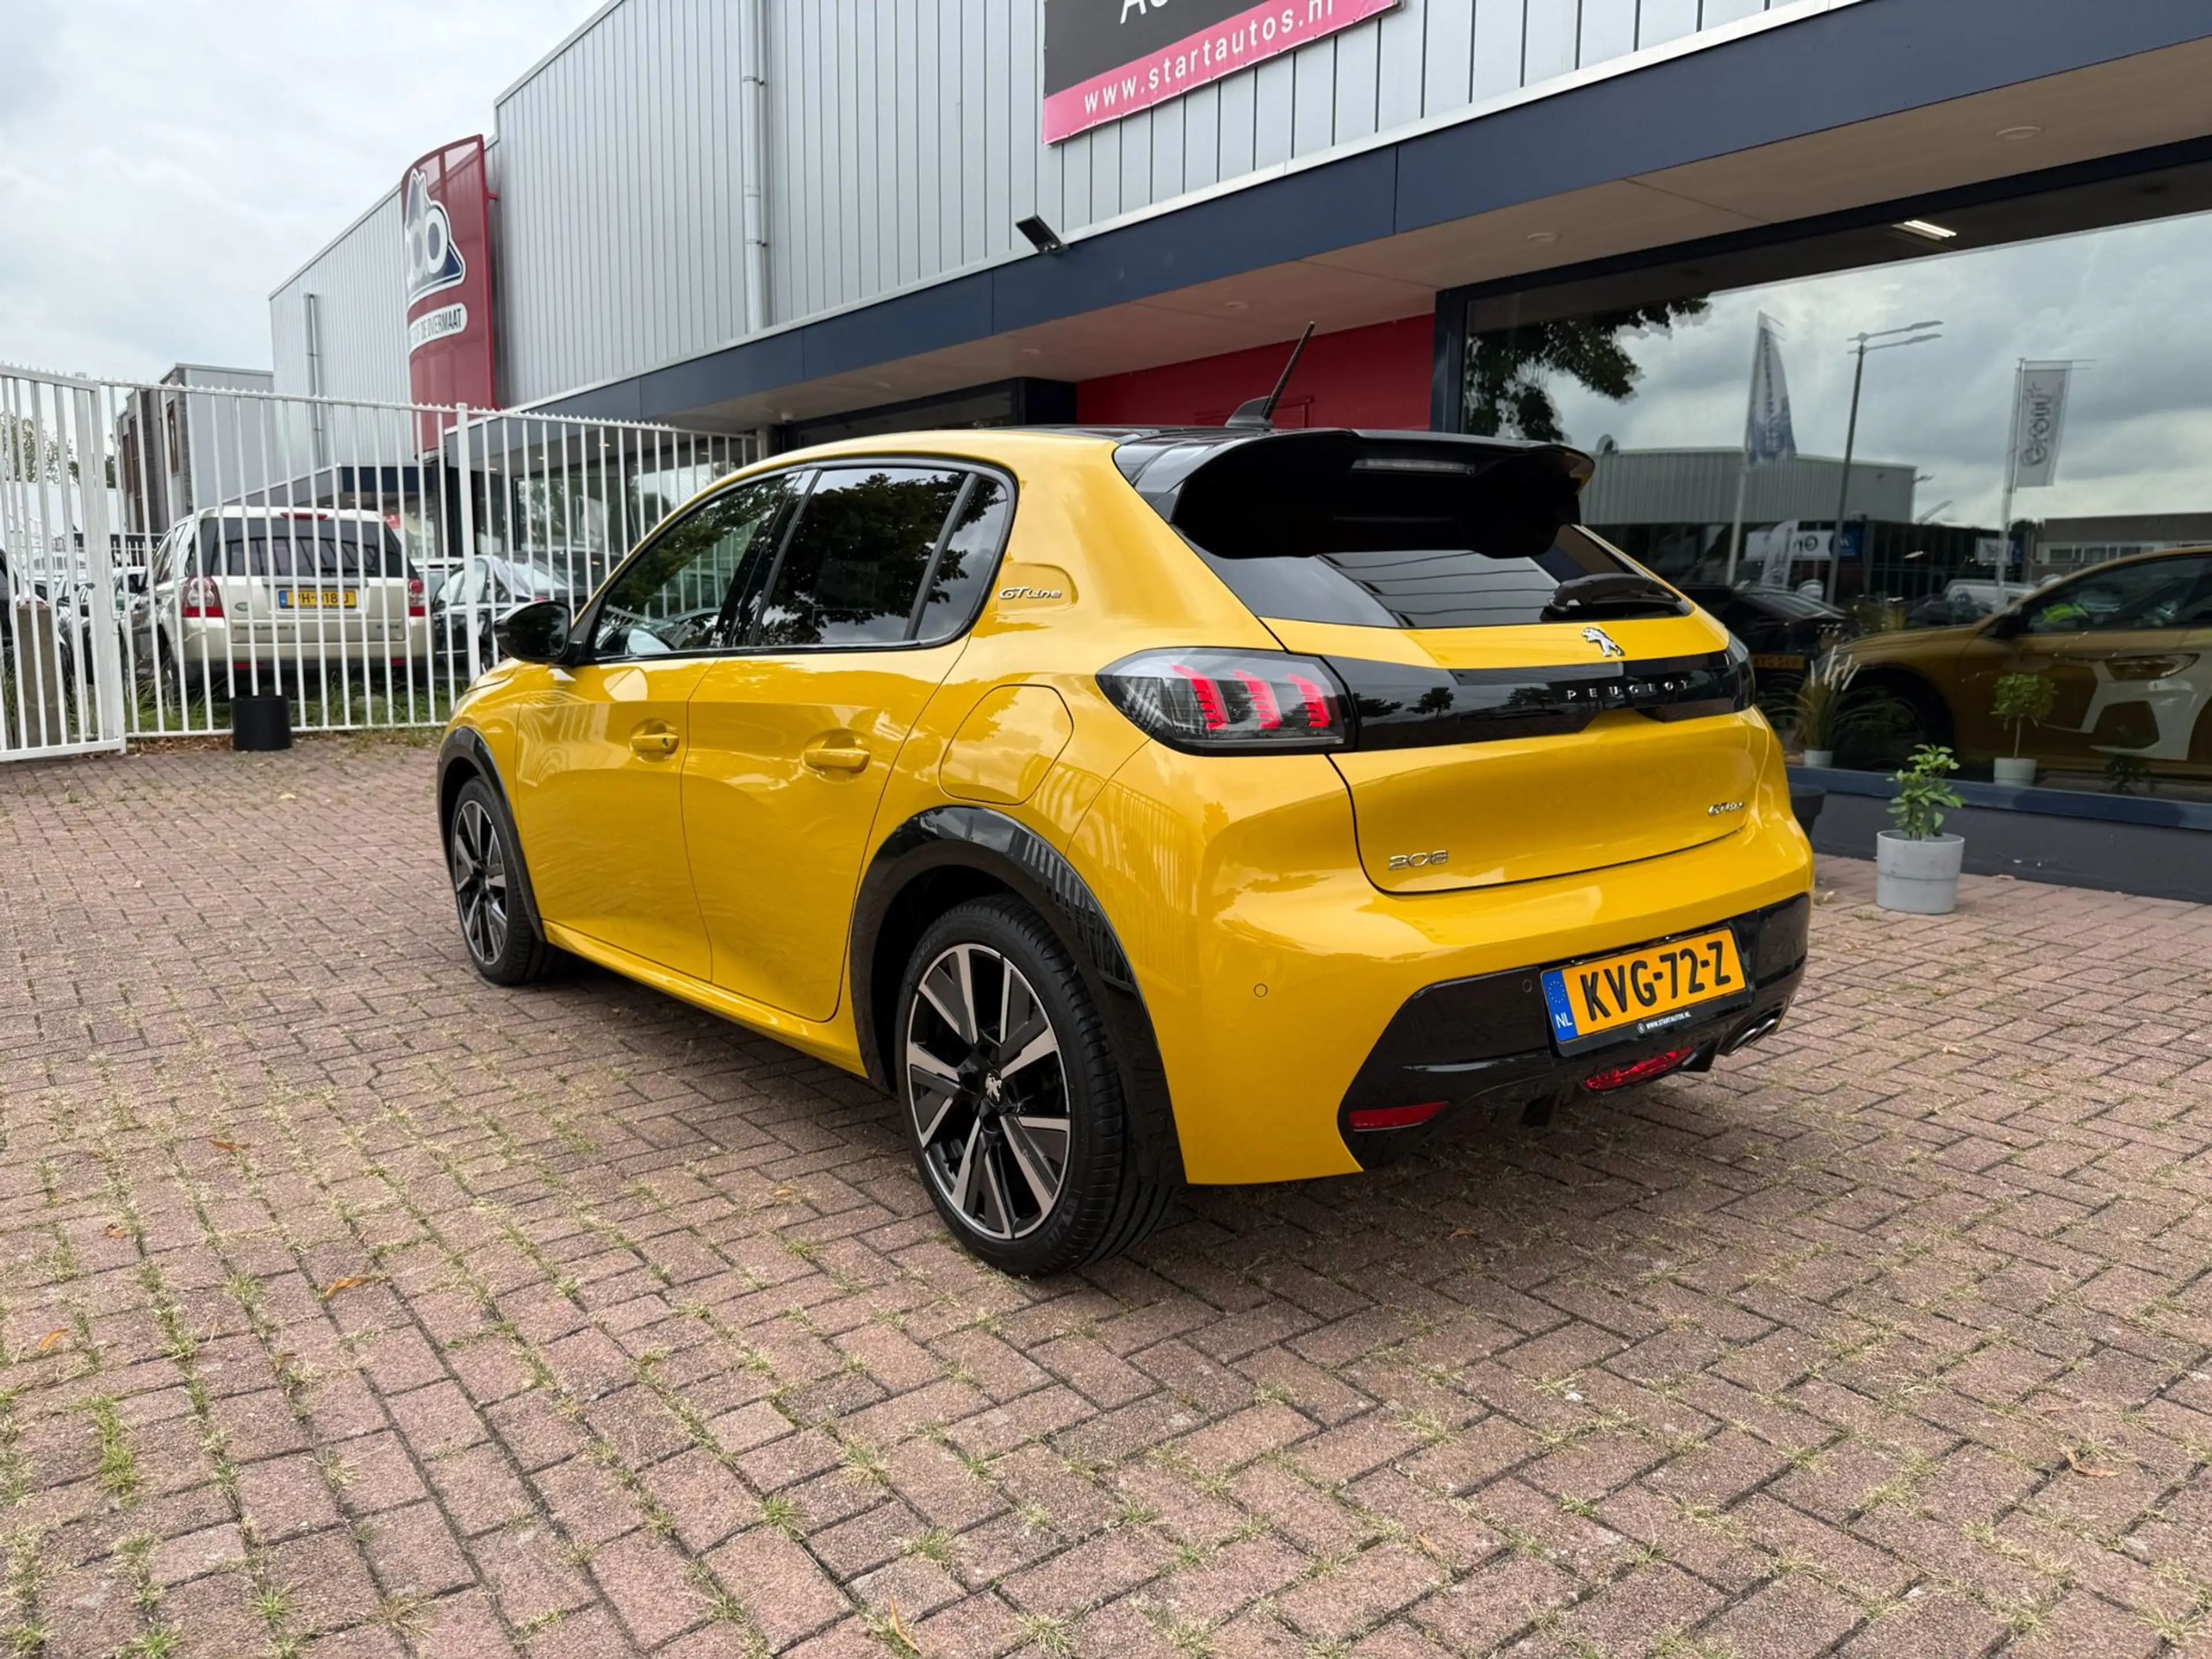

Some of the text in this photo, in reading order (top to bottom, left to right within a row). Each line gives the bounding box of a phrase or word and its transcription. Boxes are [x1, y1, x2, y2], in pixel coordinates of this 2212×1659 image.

[1566, 679, 1690, 700] PEUGEOT
[1388, 850, 1449, 871] 208
[1580, 940, 1732, 1022] KVG-72-Z
[1555, 1012, 1573, 1029] NL
